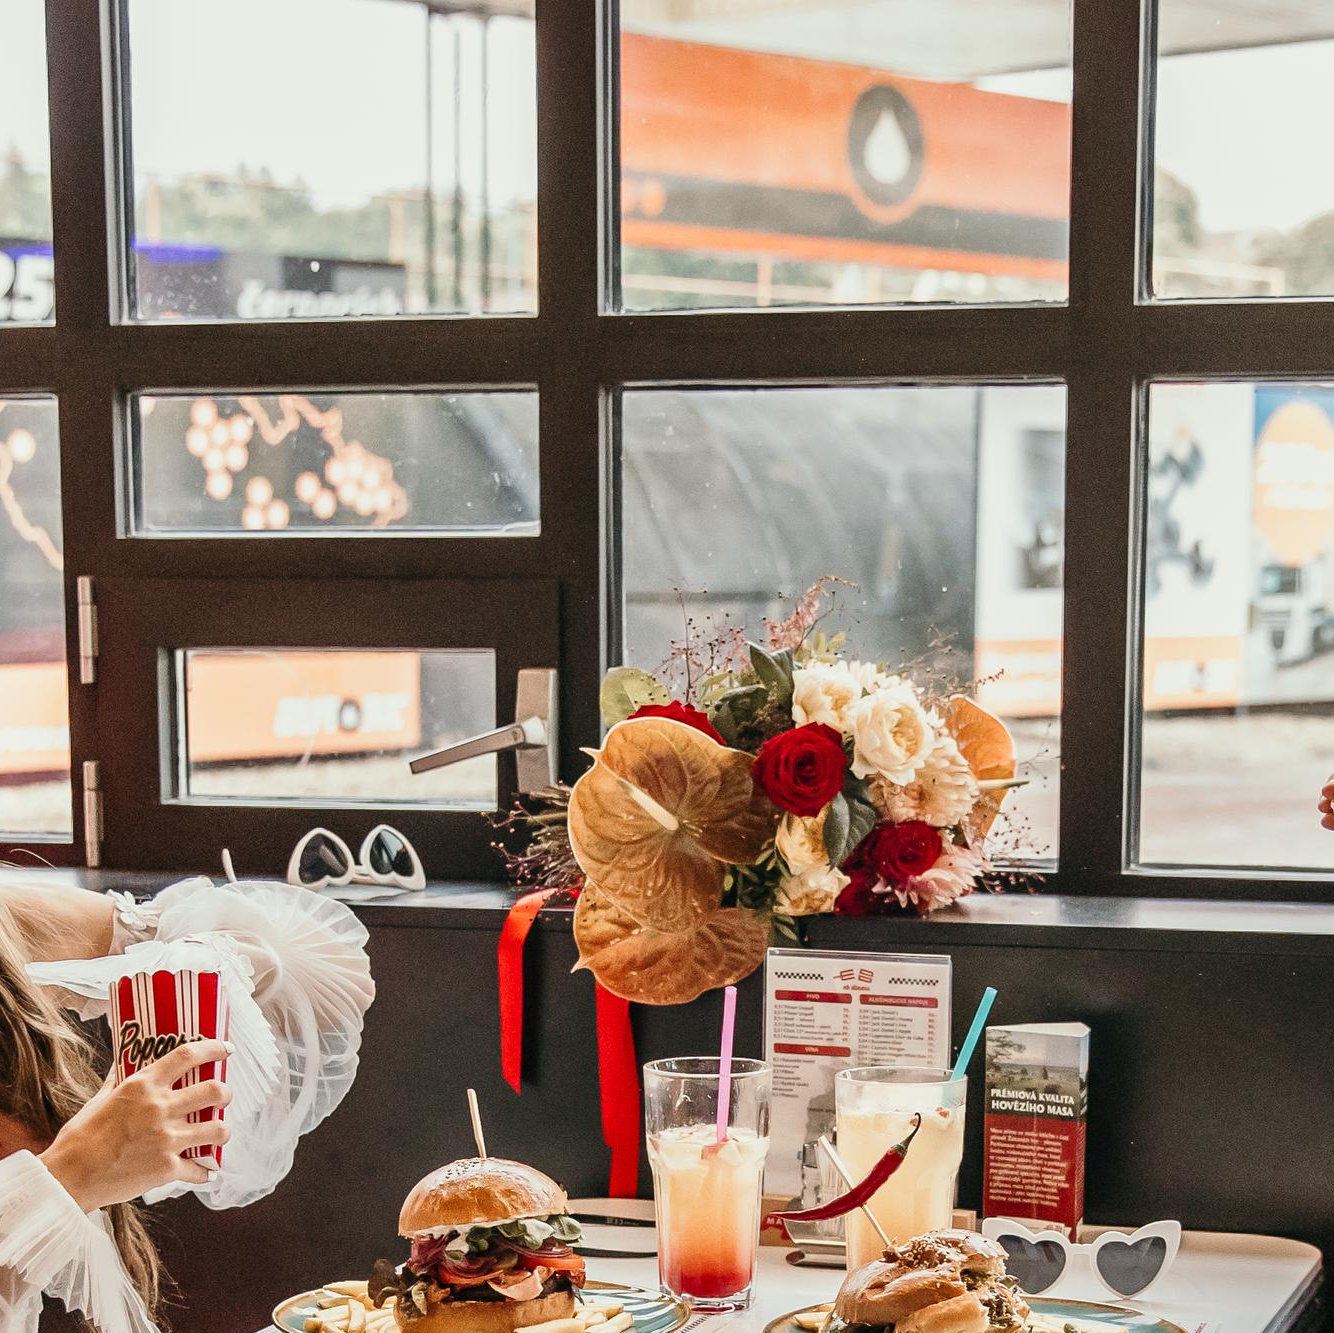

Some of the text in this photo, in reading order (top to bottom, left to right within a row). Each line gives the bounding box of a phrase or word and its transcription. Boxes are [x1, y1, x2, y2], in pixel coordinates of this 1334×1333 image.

[118, 1020, 208, 1072] Popco
[990, 1087, 1037, 1101] PRÉMIOVÁ
[1038, 1092, 1075, 1105] KVALITA
[991, 1099, 1074, 1118] HOVĚZÍHO MASA
